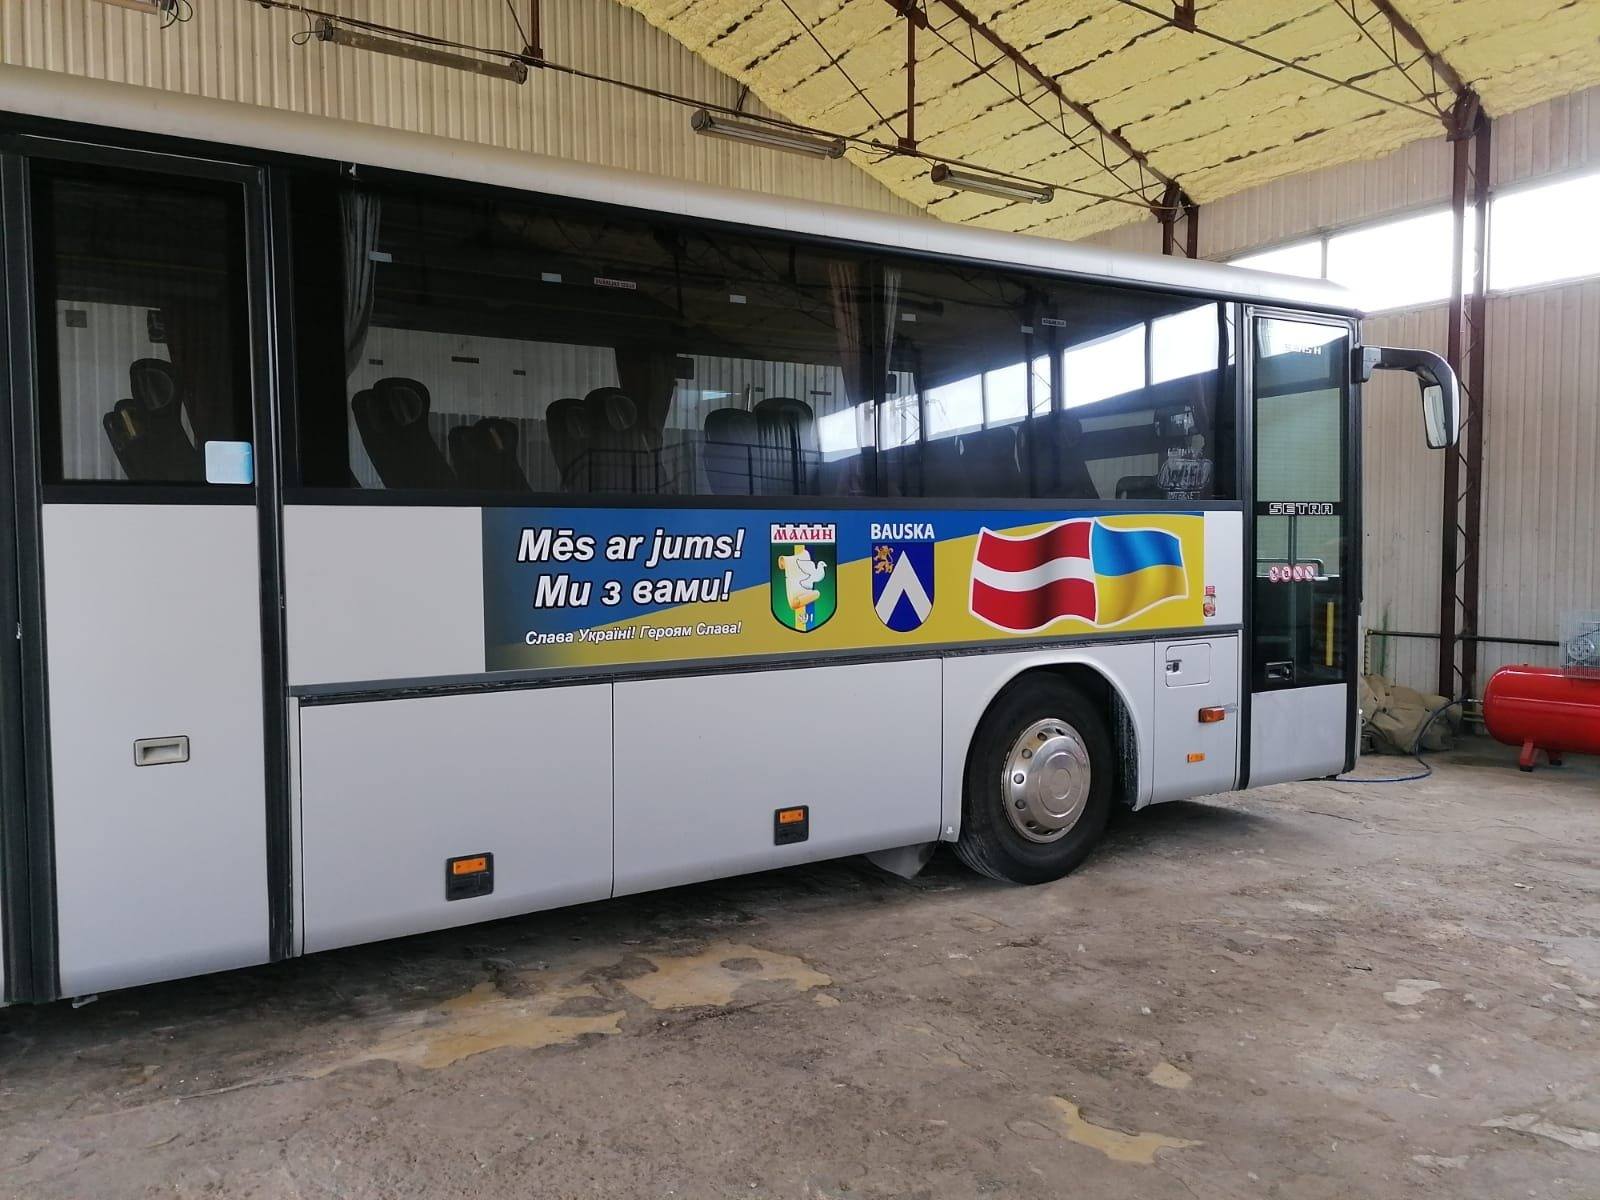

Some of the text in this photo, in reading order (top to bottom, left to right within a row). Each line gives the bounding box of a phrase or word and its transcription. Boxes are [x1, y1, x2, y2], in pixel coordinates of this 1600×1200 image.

[1269, 502, 1333, 515] SETRA
[871, 523, 935, 540] BAUSKA
[517, 528, 745, 567] Mēs ar jums!
[534, 571, 733, 608] Ми з вами!
[525, 621, 742, 645] Слава Україні! Героям Слава!
